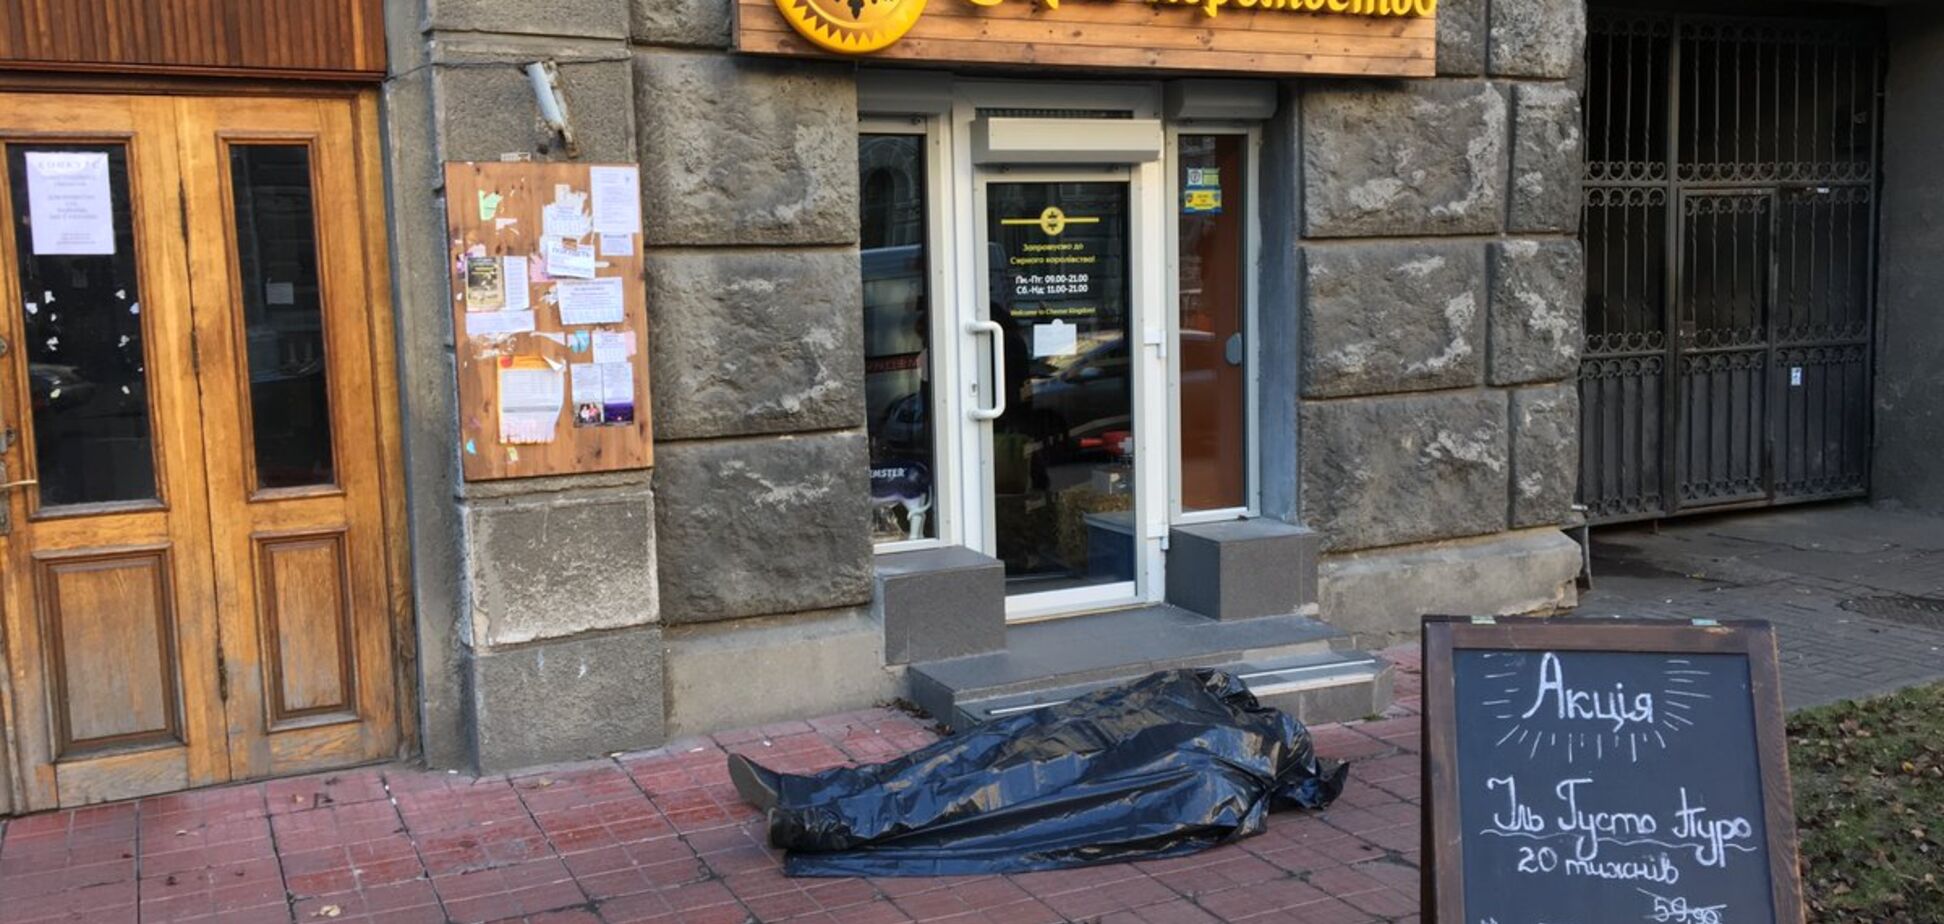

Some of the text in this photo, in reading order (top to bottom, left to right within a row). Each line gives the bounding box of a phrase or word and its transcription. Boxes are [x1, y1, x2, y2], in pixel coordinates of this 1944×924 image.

[1521, 652, 1653, 733] Акція
[1555, 777, 1657, 861] Густо
[1517, 846, 1680, 884] 20 тижнів
